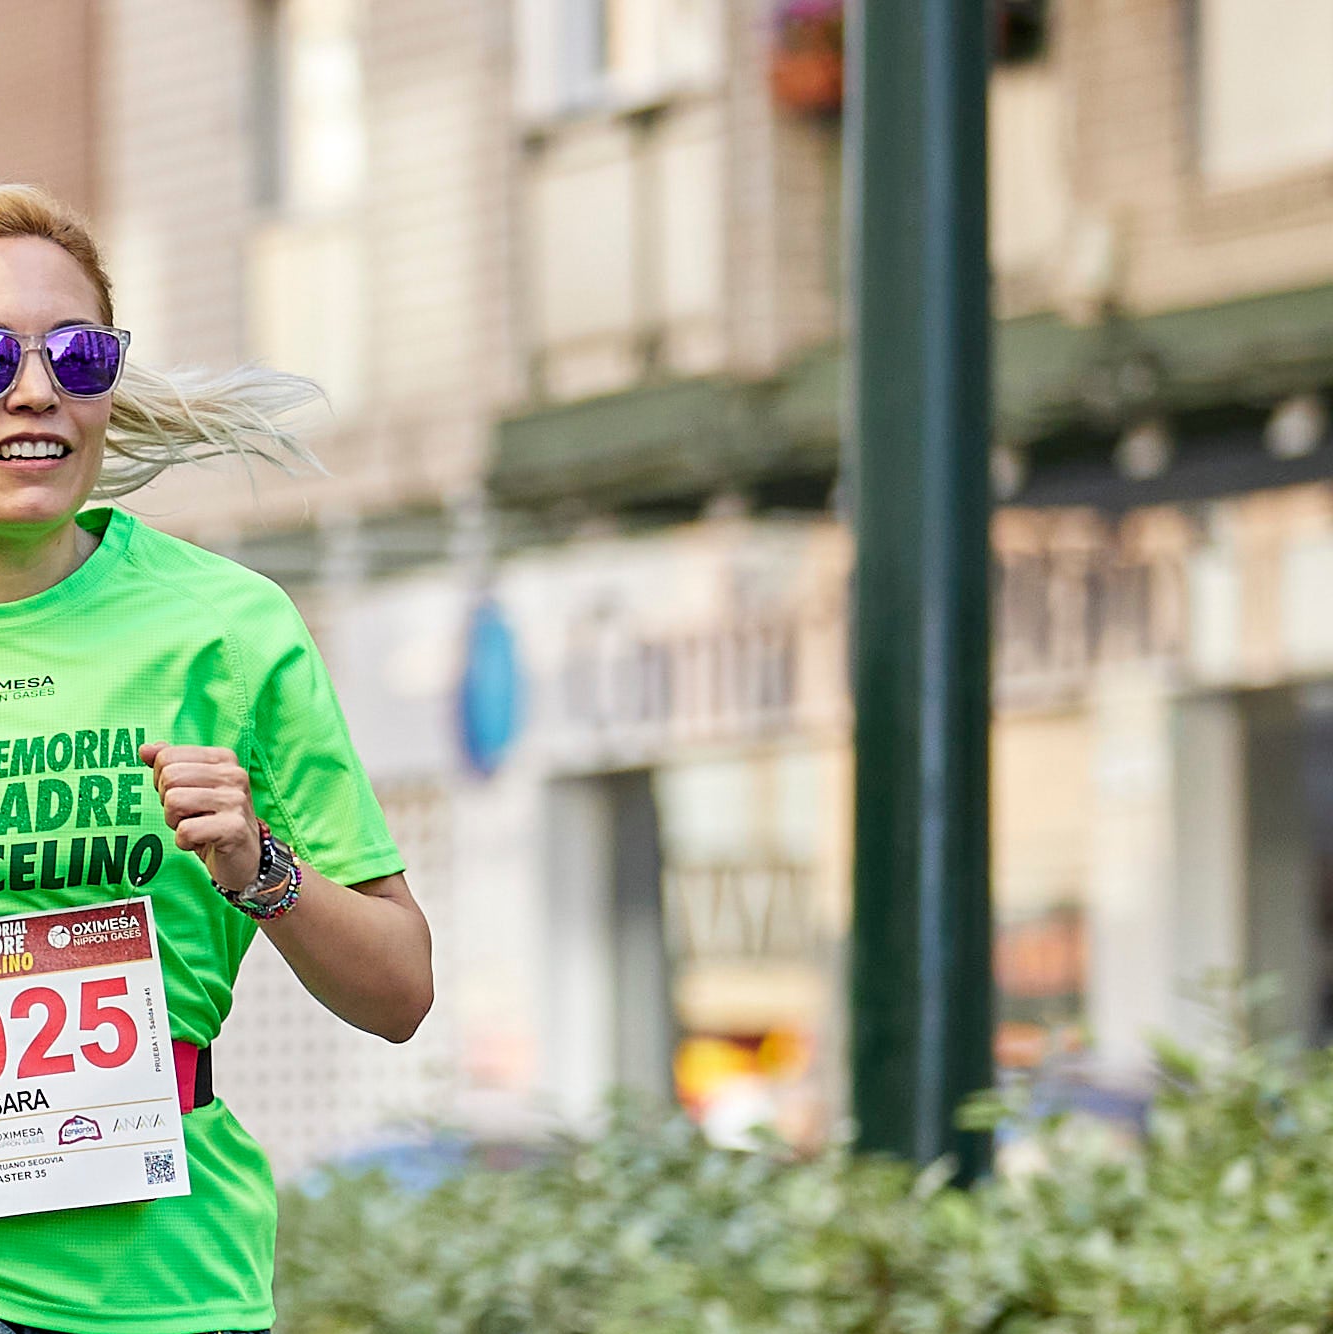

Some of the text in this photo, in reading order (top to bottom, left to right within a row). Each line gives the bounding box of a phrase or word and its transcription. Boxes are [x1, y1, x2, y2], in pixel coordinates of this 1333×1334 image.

[13, 687, 55, 700] GASES
[71, 914, 140, 935] OXIMESA
[72, 928, 142, 947] NIPPON GASES
[150, 1041, 162, 1073] PRUEBA
[64, 1125, 95, 1138] Lanjarón
[27, 1155, 64, 1168] SEGOVIA
[35, 1169, 47, 1180] 35
